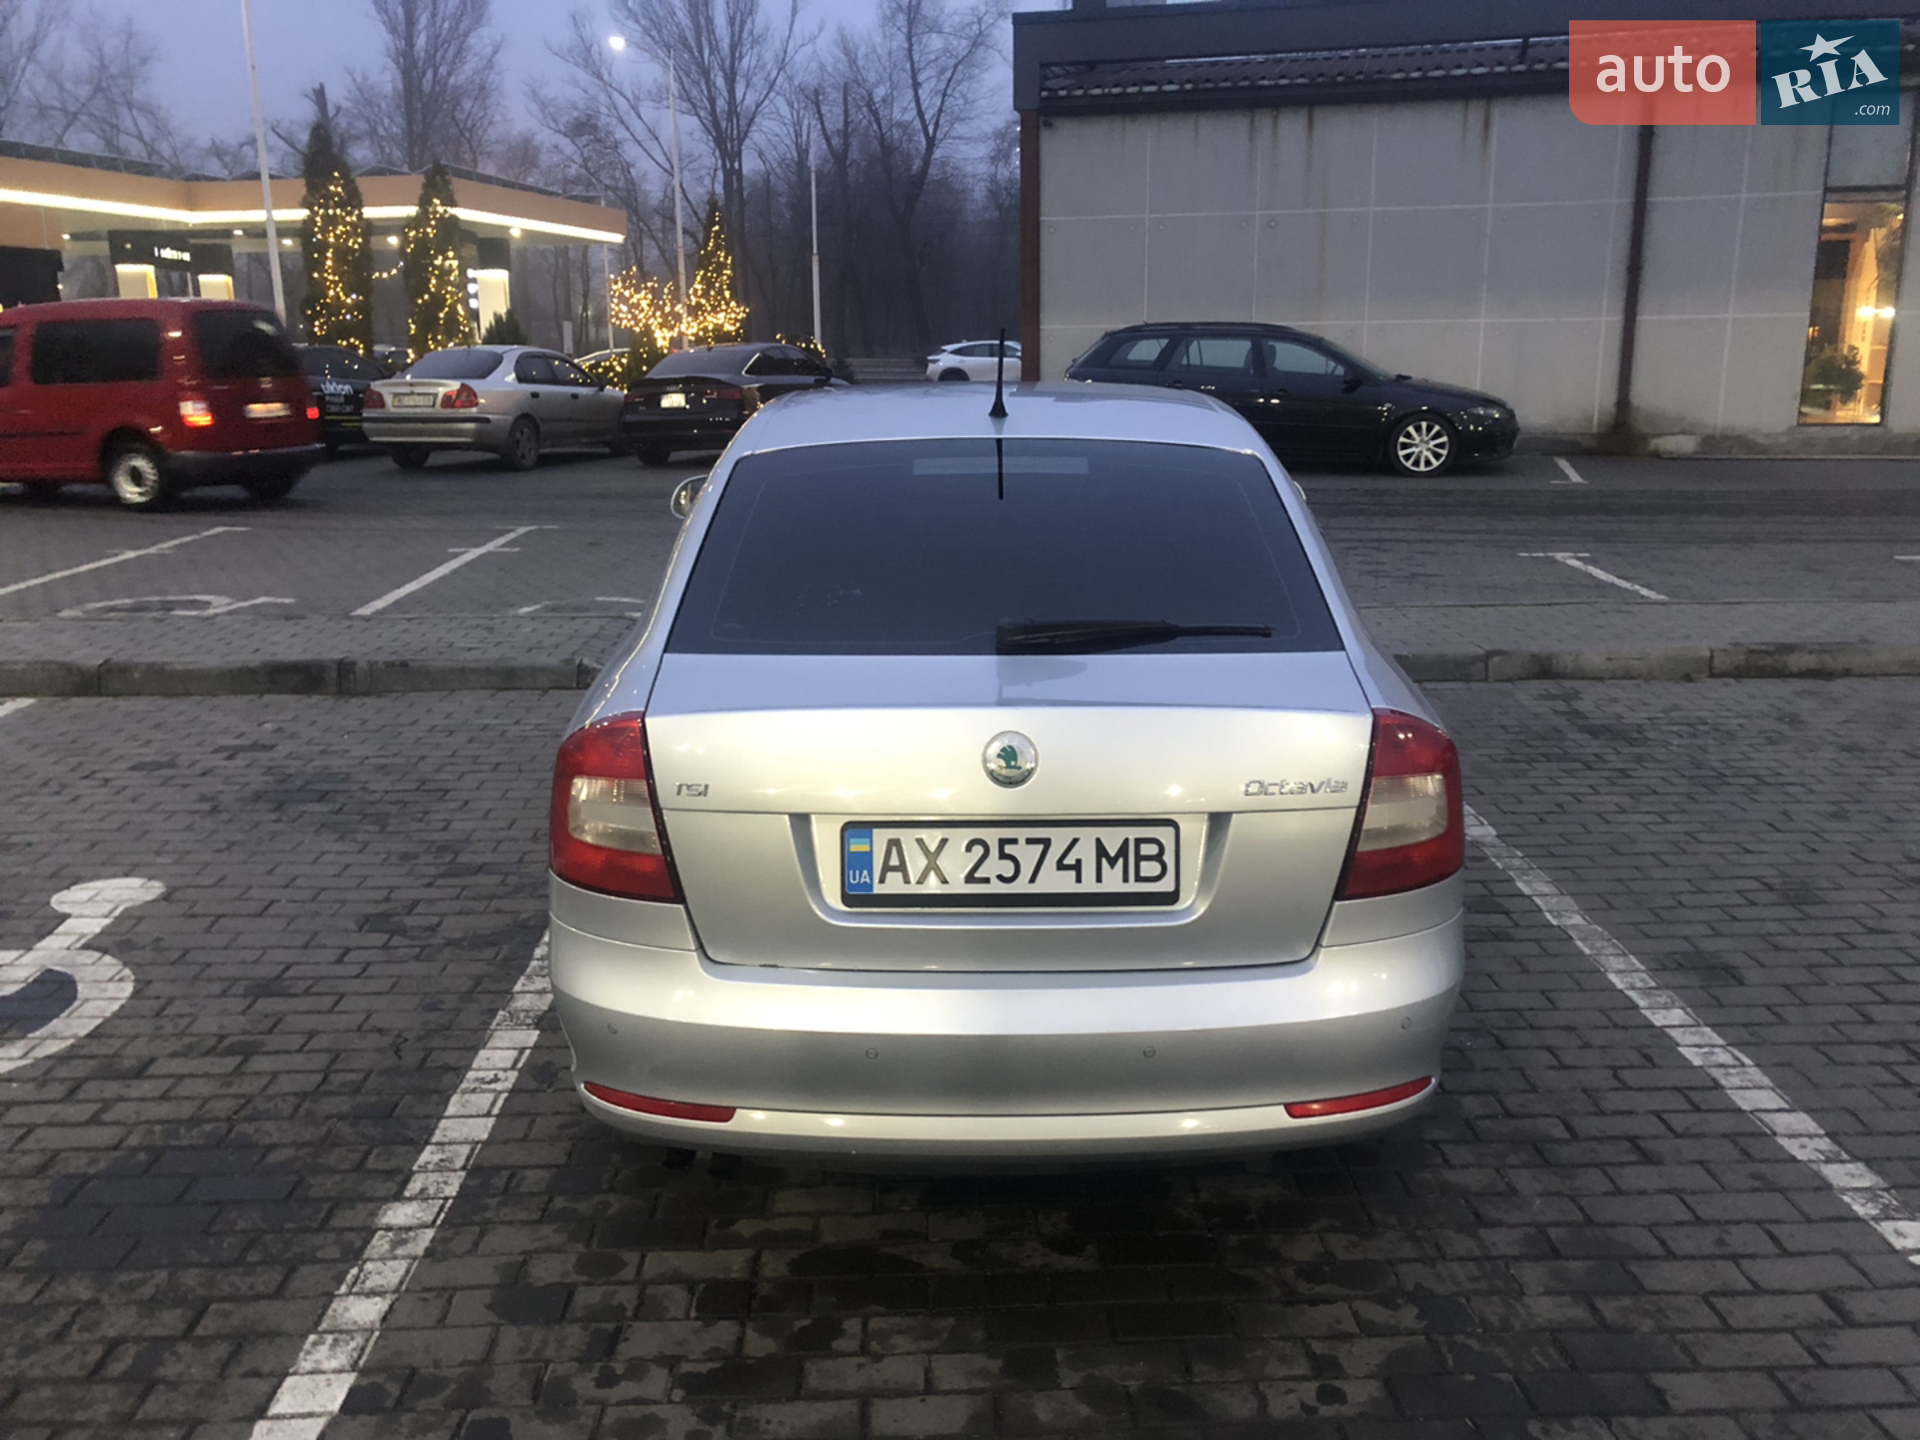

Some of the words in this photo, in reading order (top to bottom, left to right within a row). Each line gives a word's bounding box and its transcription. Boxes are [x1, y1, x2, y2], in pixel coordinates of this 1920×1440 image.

[674, 783, 709, 797] TSI
[1244, 779, 1348, 796] Octavia
[877, 837, 949, 885] AX
[963, 837, 1082, 884] 2574
[1095, 836, 1168, 883] MB
[849, 869, 871, 884] UA
